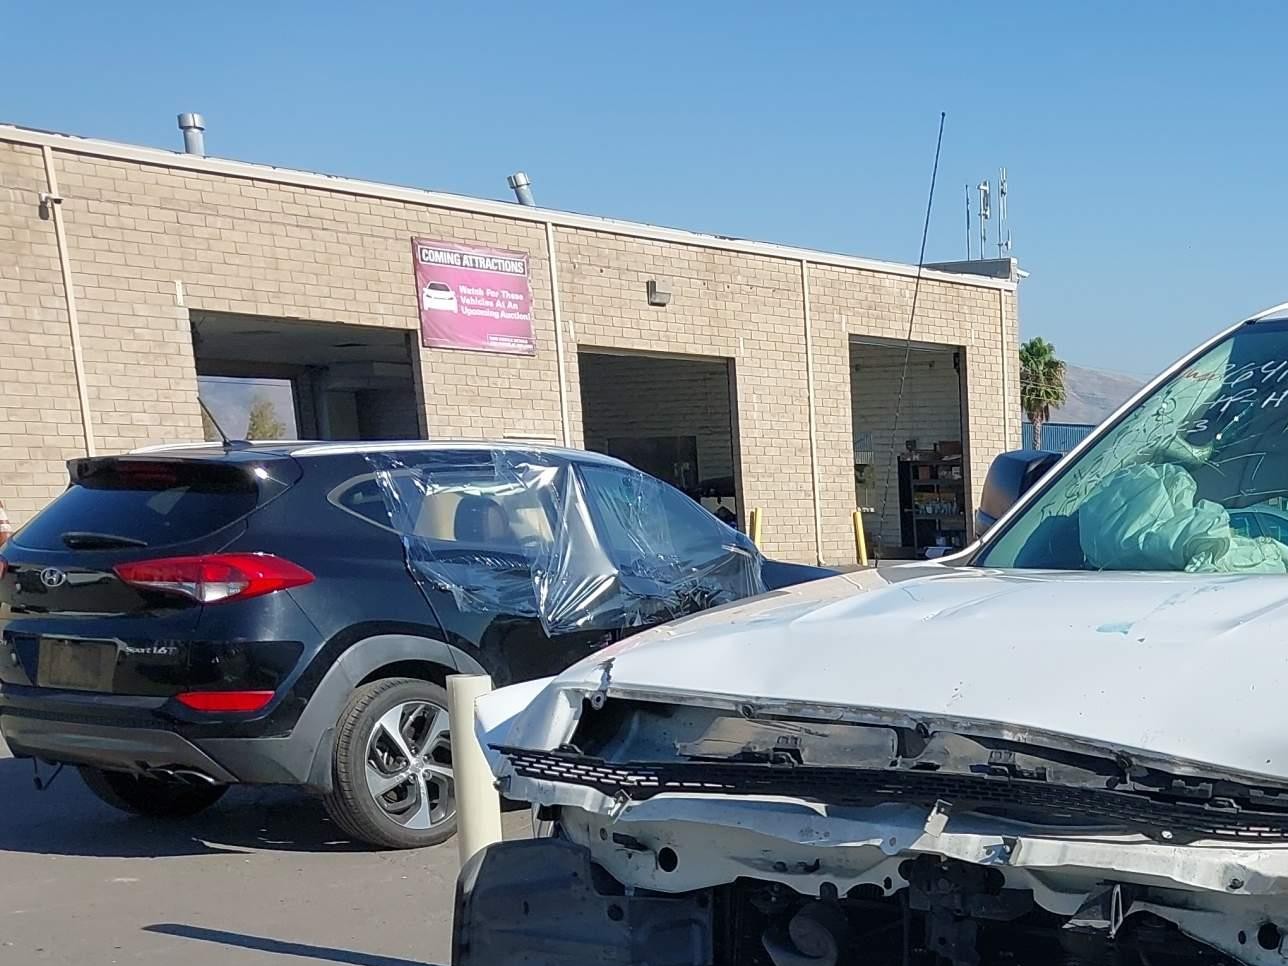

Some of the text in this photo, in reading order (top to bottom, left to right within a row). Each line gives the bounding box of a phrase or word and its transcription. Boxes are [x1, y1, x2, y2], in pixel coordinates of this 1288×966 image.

[422, 249, 524, 273] COMING ATTRACTIONS
[460, 286, 524, 301] Watch For These
[460, 295, 519, 310] Vehicles At An
[461, 306, 530, 320] Upcoming Auction!
